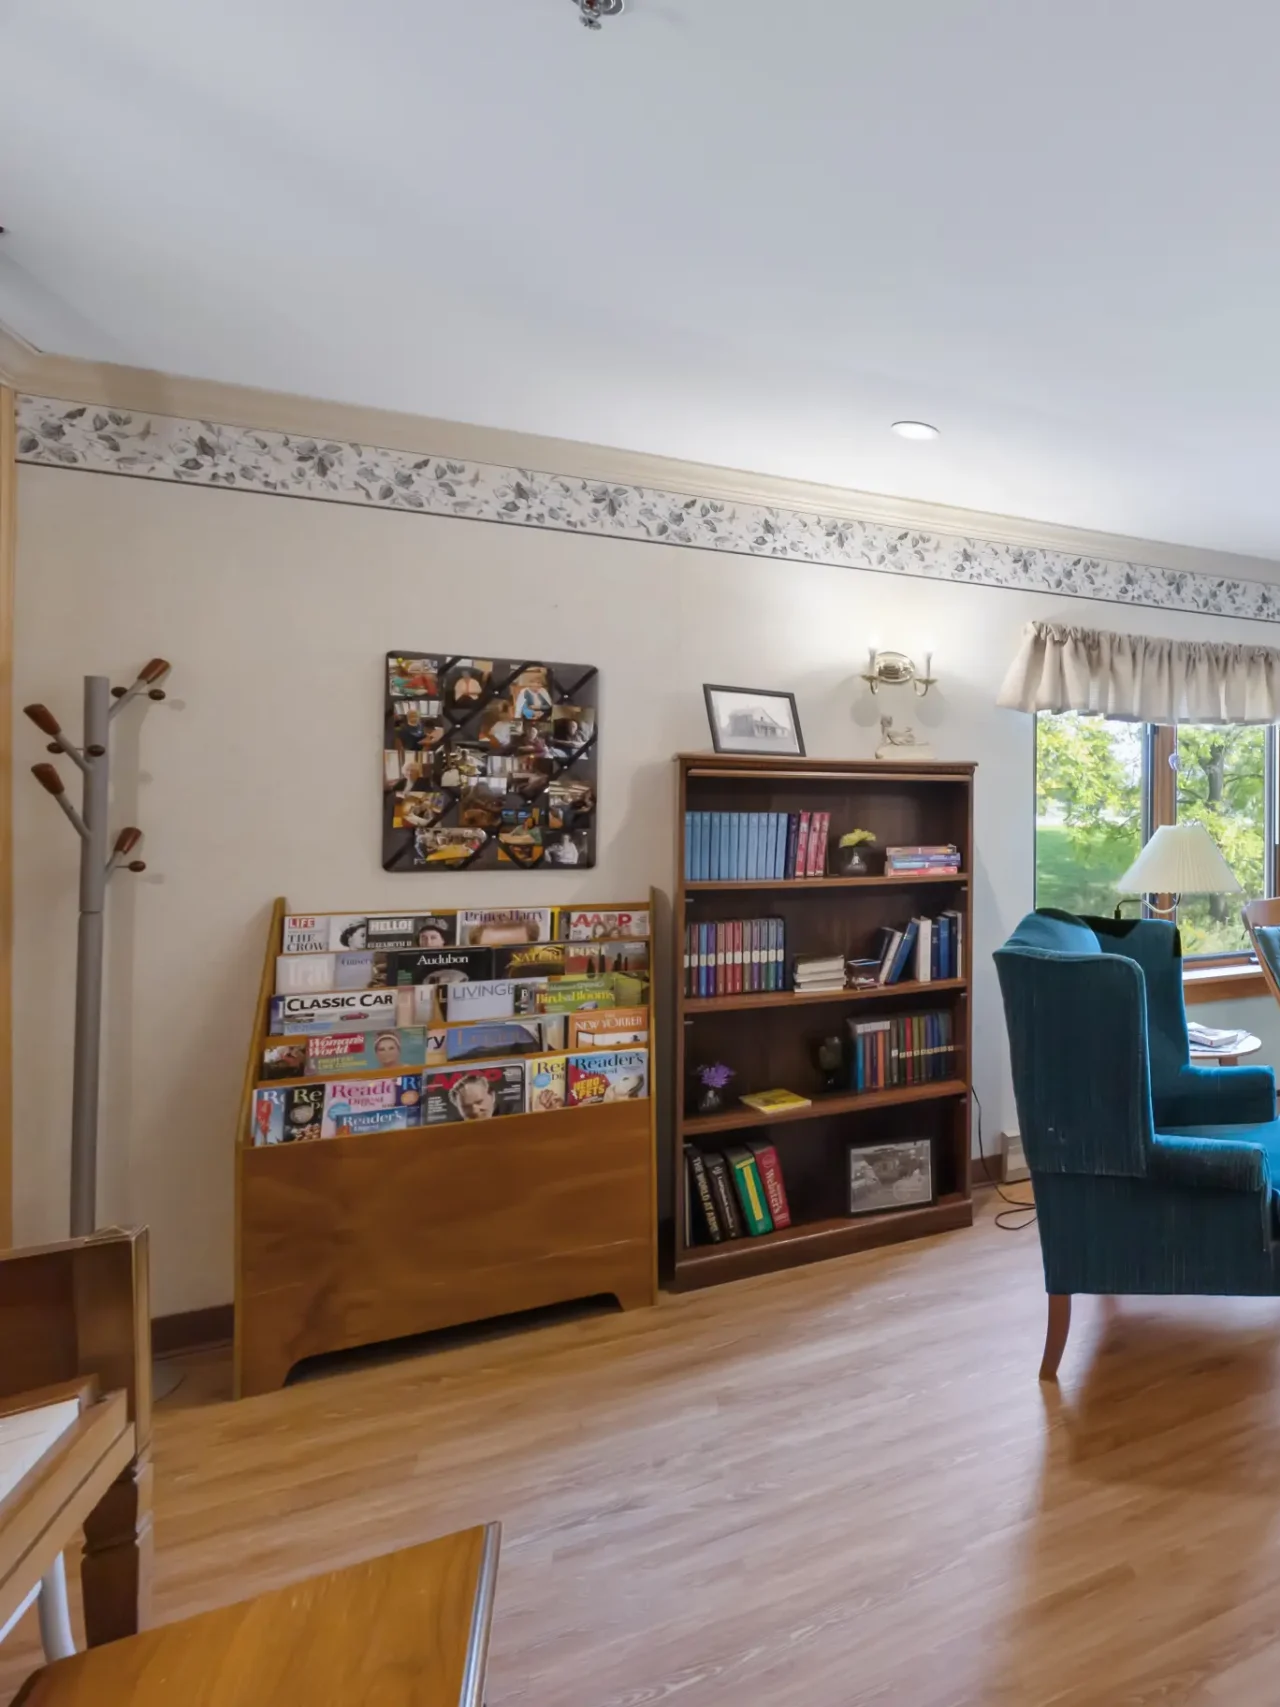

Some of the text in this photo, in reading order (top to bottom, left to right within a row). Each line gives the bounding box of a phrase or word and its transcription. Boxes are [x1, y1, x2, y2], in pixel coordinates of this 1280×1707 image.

[289, 918, 315, 928] LIFE
[464, 910, 543, 922] Prince Harry
[571, 913, 633, 927] AARP
[370, 920, 412, 931] HELLO!
[288, 934, 315, 943] THE
[417, 954, 469, 965] Audubon
[287, 997, 356, 1012] CLASSIC
[360, 994, 393, 1007] CAR
[536, 991, 566, 1003] Birds
[572, 990, 615, 1001] Blooms
[575, 1016, 642, 1030] NEW YORKER
[309, 1034, 365, 1048] Woman's
[309, 1045, 349, 1057] World
[575, 1053, 643, 1070] Reader's
[574, 1077, 600, 1090] HERO
[578, 1085, 605, 1099] PETS
[342, 1110, 403, 1126] Reader's
[692, 1157, 704, 1174] THE
[696, 1173, 710, 1201] WORLD
[765, 1168, 782, 1214] Webster's
[703, 1202, 714, 1211] AT
